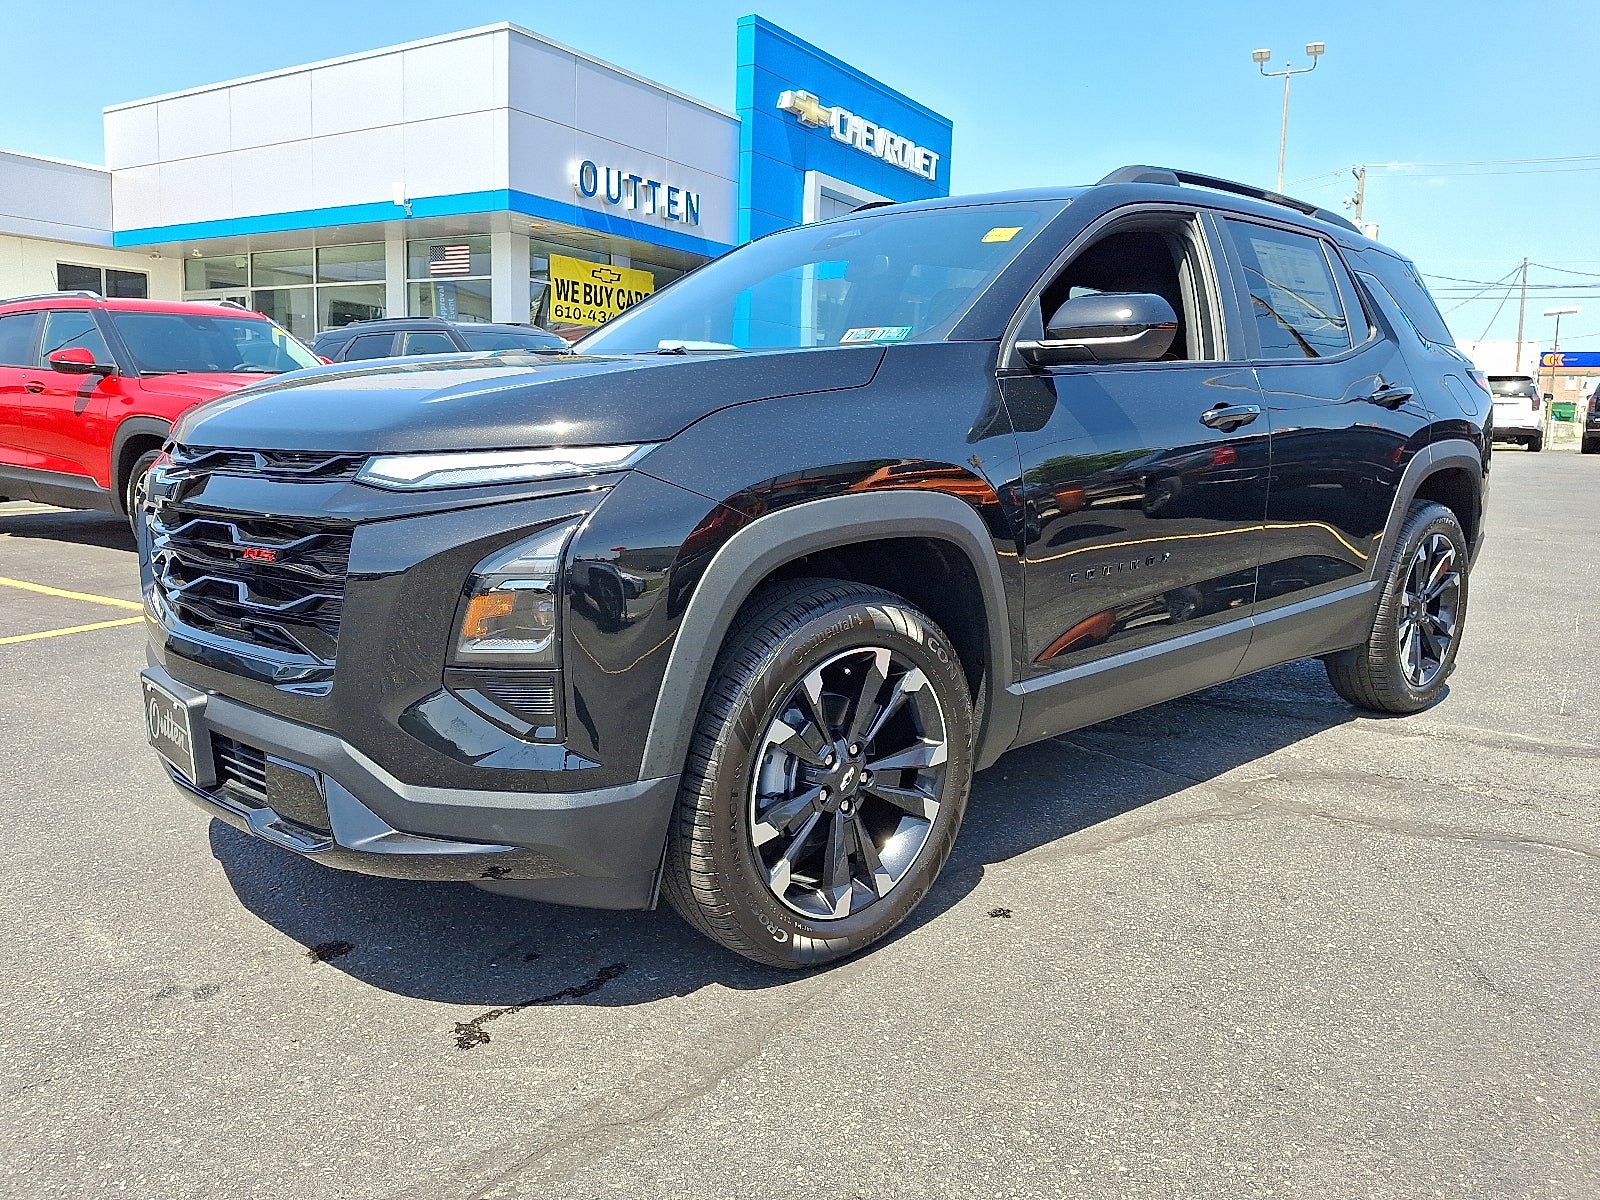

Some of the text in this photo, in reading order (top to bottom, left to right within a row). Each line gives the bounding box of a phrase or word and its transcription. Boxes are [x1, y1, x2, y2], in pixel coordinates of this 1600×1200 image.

[829, 106, 939, 181] CHEVROLET
[578, 160, 700, 226] OUTTEN
[554, 277, 651, 311] WE BUY CA
[242, 547, 276, 562] RS
[149, 697, 191, 756] Outten
